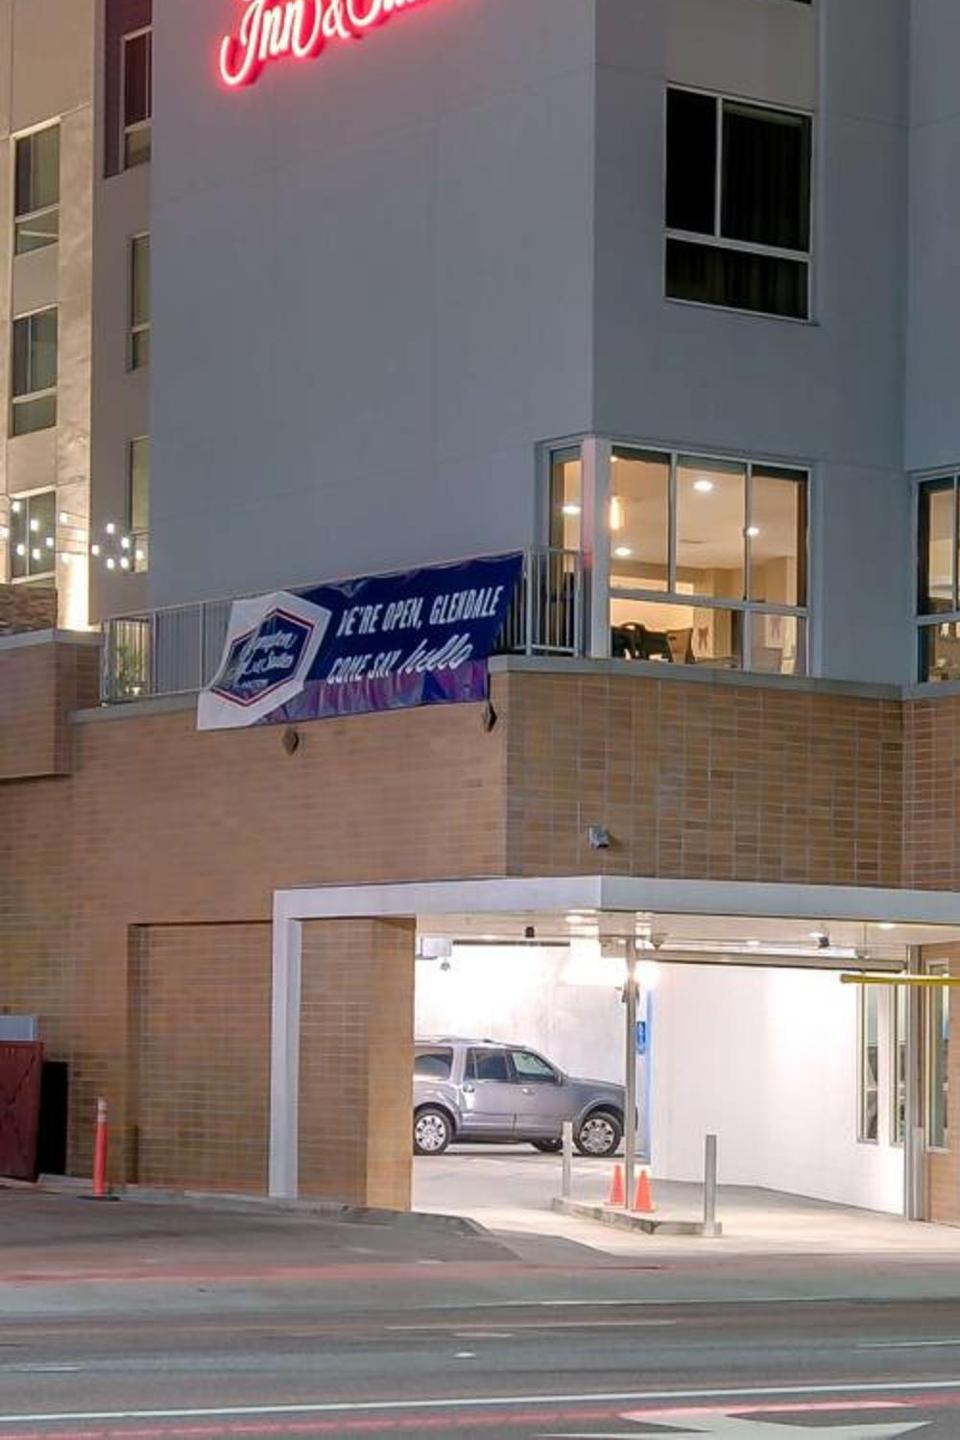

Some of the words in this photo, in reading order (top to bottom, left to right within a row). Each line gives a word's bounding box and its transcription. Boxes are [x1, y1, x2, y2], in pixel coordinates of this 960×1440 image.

[429, 585, 505, 625] GLENDALE
[326, 654, 373, 685] COME
[397, 632, 474, 675] hello
